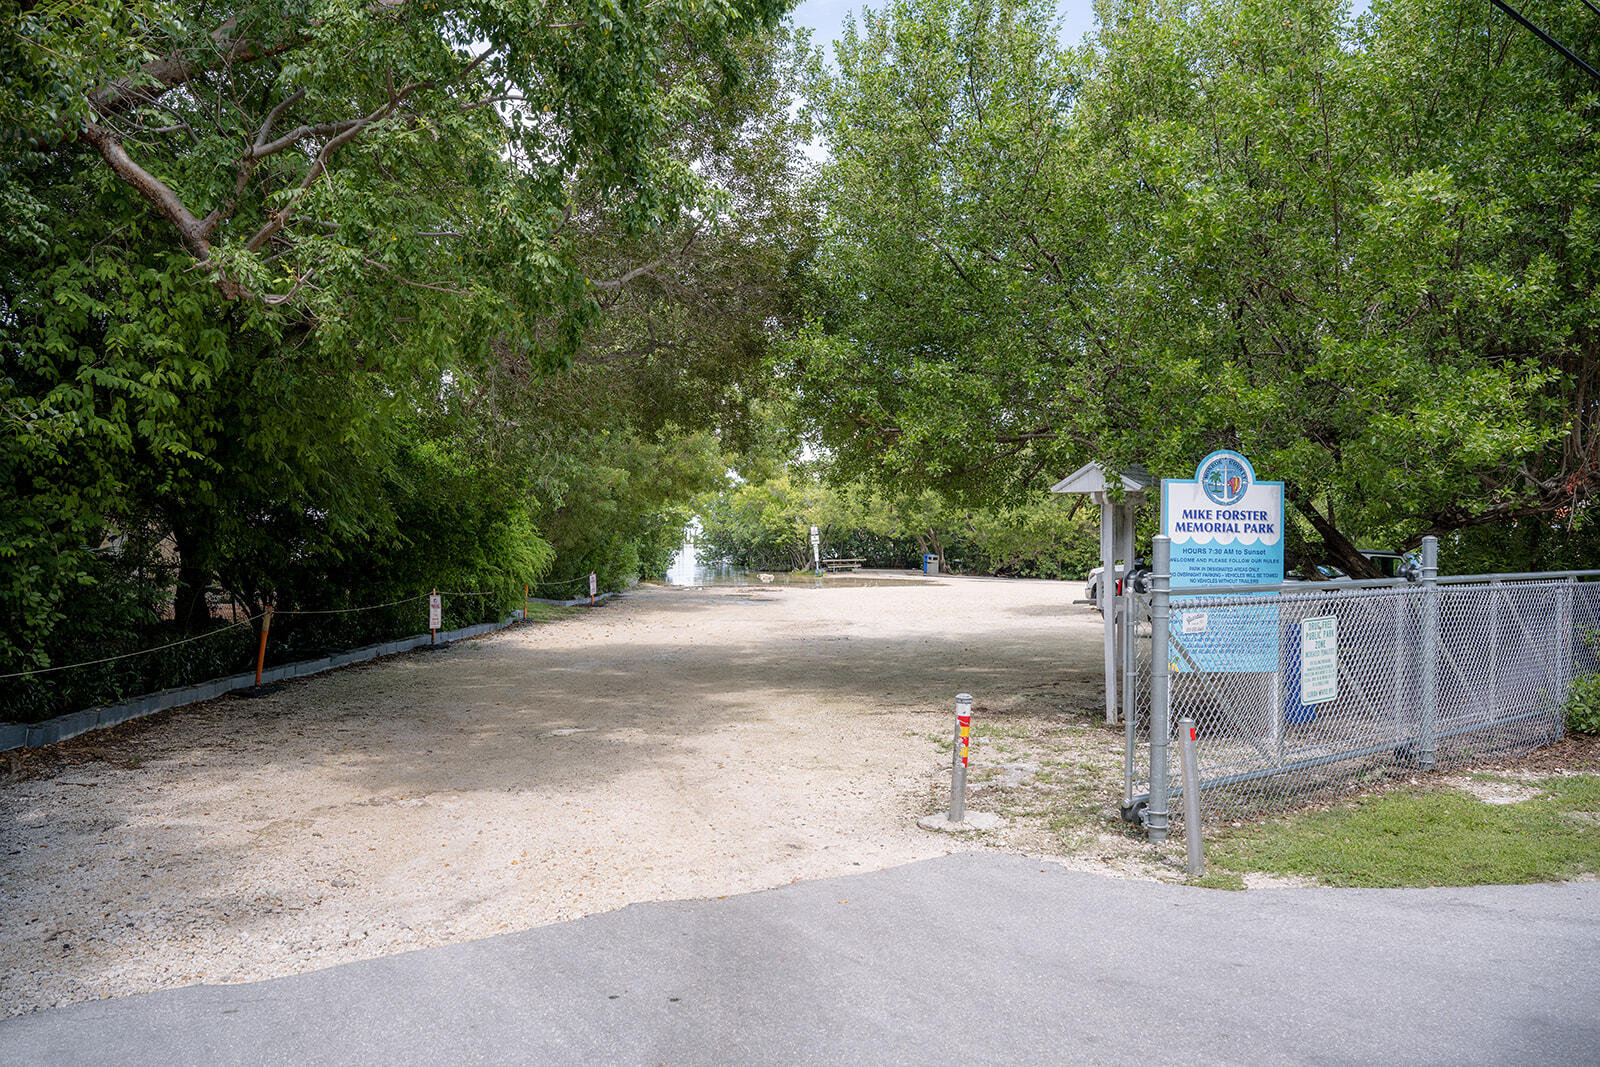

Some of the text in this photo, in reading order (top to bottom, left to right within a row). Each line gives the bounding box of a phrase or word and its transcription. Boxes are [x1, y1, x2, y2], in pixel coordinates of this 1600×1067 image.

[1182, 509, 1268, 521] MIKE FORSTER
[1175, 522, 1275, 534] MEMORIAL PARK
